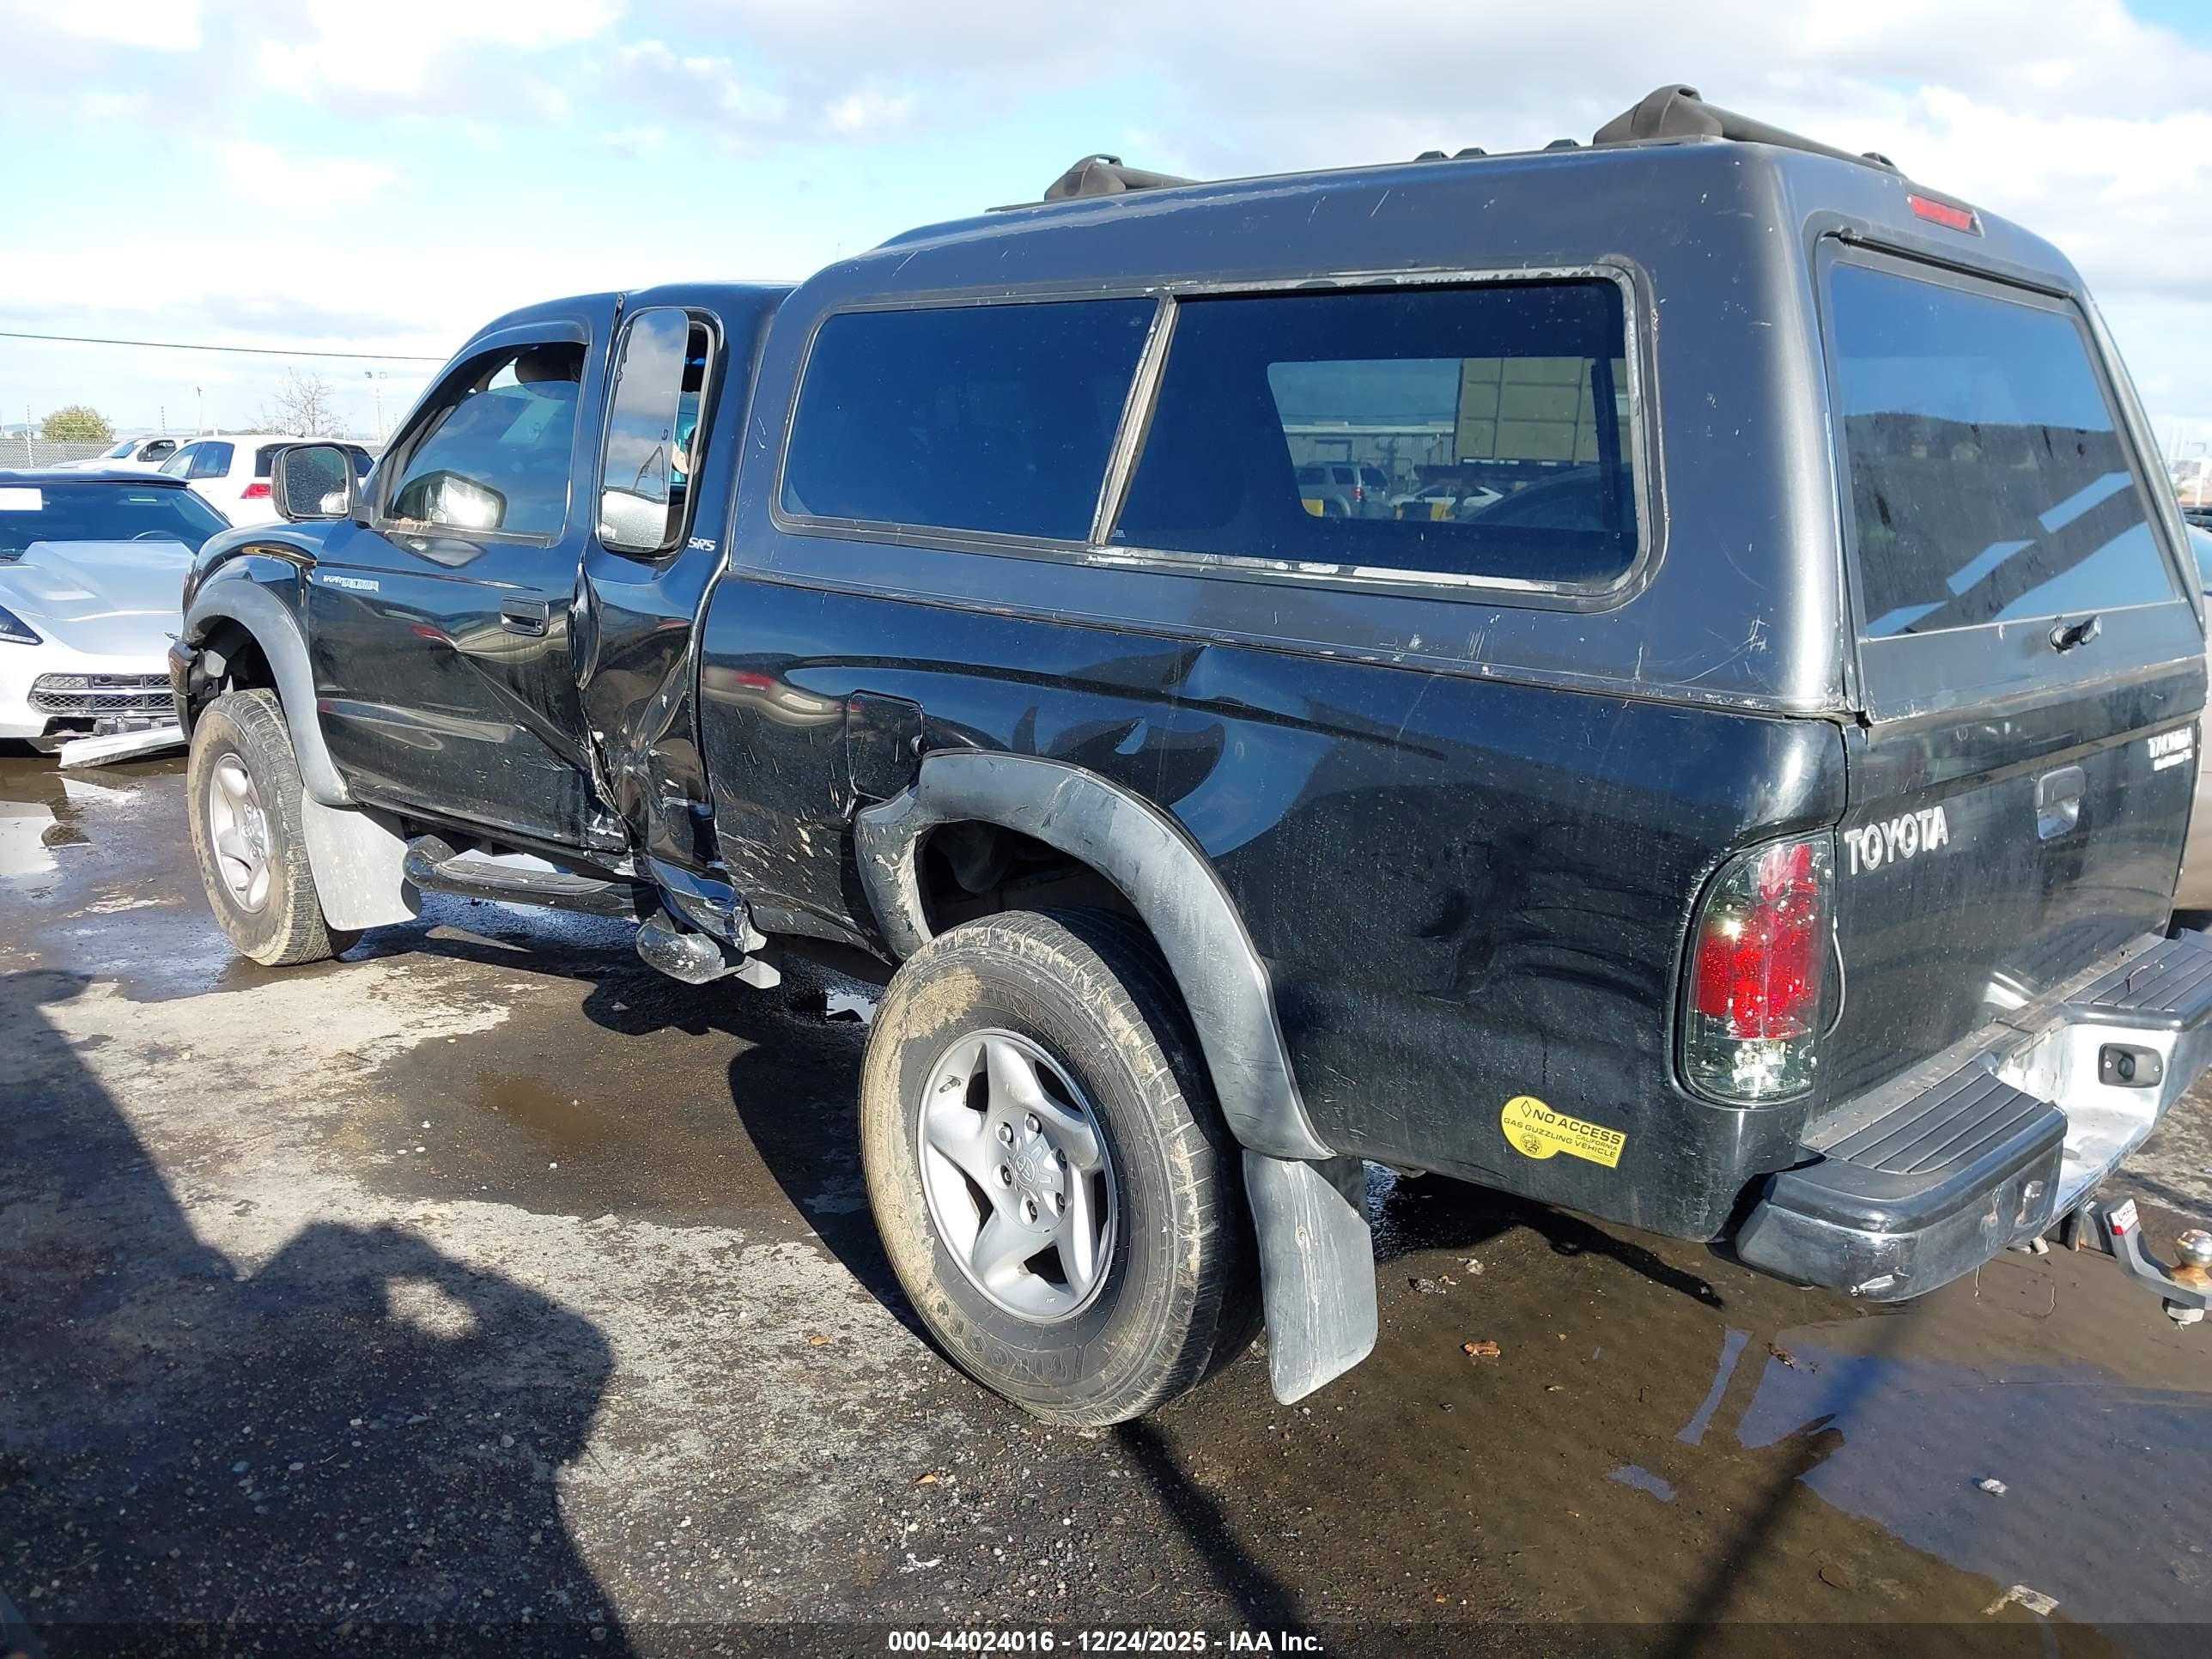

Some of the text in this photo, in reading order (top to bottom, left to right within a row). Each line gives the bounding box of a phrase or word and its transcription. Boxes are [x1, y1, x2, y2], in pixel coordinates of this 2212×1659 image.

[1844, 805, 1949, 875] TOYOTA
[1504, 1117, 1523, 1128] GAS
[1524, 1124, 1572, 1145] GUZZLING
[1575, 1140, 1616, 1158] VEHICLE
[1533, 1109, 1621, 1145] NO ACCESS
[1576, 1134, 1618, 1151] CALIFORNIA
